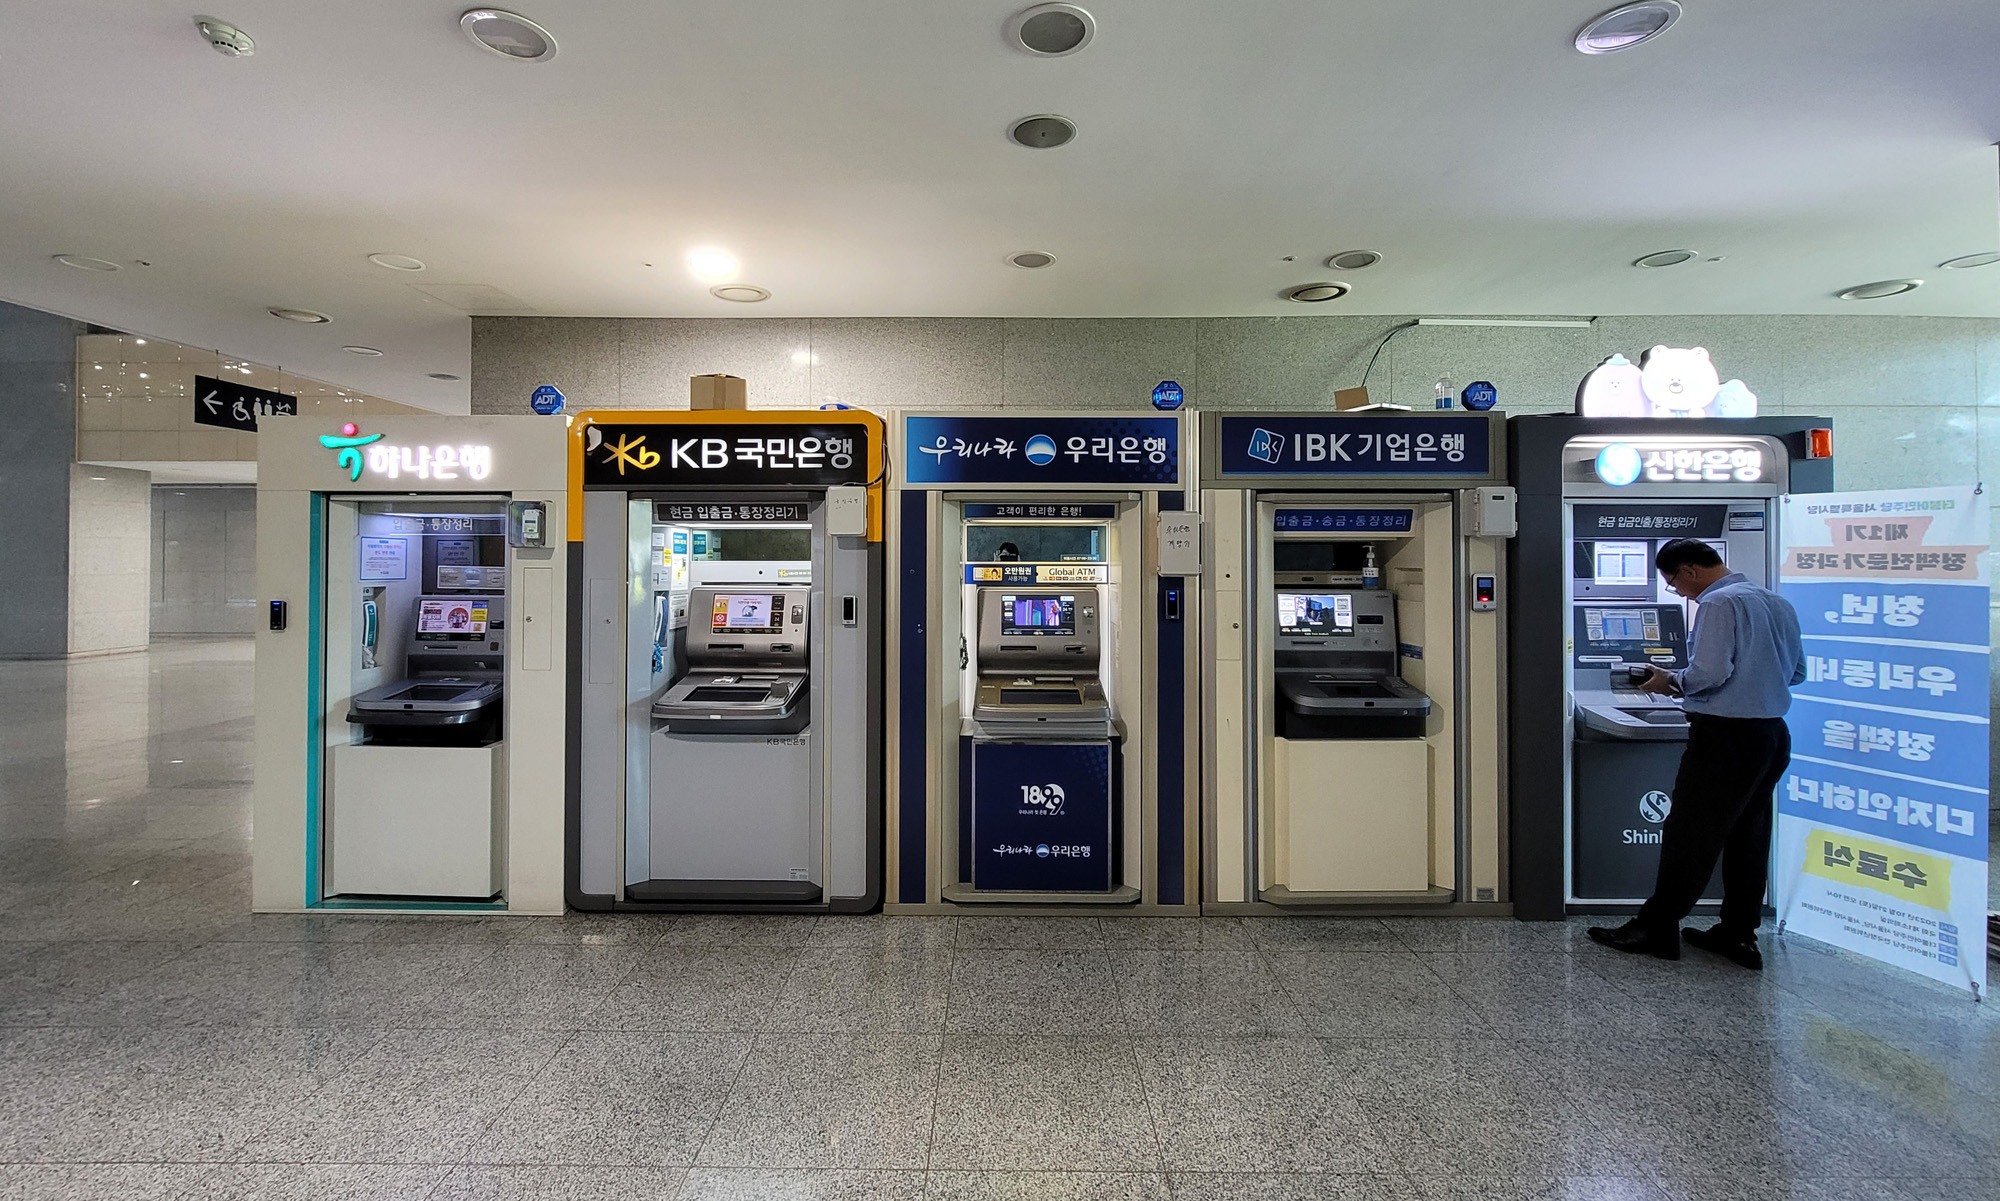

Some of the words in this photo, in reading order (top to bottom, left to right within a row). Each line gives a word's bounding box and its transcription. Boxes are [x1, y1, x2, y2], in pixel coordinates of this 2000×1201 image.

[535, 394, 555, 404] ADT
[1159, 390, 1178, 401] ADT
[1472, 391, 1492, 401] ADT
[919, 436, 1017, 465] 우리나라
[1064, 436, 1166, 464] 우리은행
[368, 445, 491, 480] 하나은행
[1646, 450, 1762, 481] 신한은행
[670, 506, 693, 520] 현금
[697, 506, 798, 520] 입출금·통장정리기
[996, 506, 1023, 516] 고객이
[1028, 506, 1056, 516] 편리한
[1060, 506, 1082, 516] 은행!
[1598, 516, 1616, 528] 현금
[1004, 567, 1032, 575] 오만원권
[993, 844, 1033, 857] 우리나라
[1051, 845, 1091, 857] 우리은행
